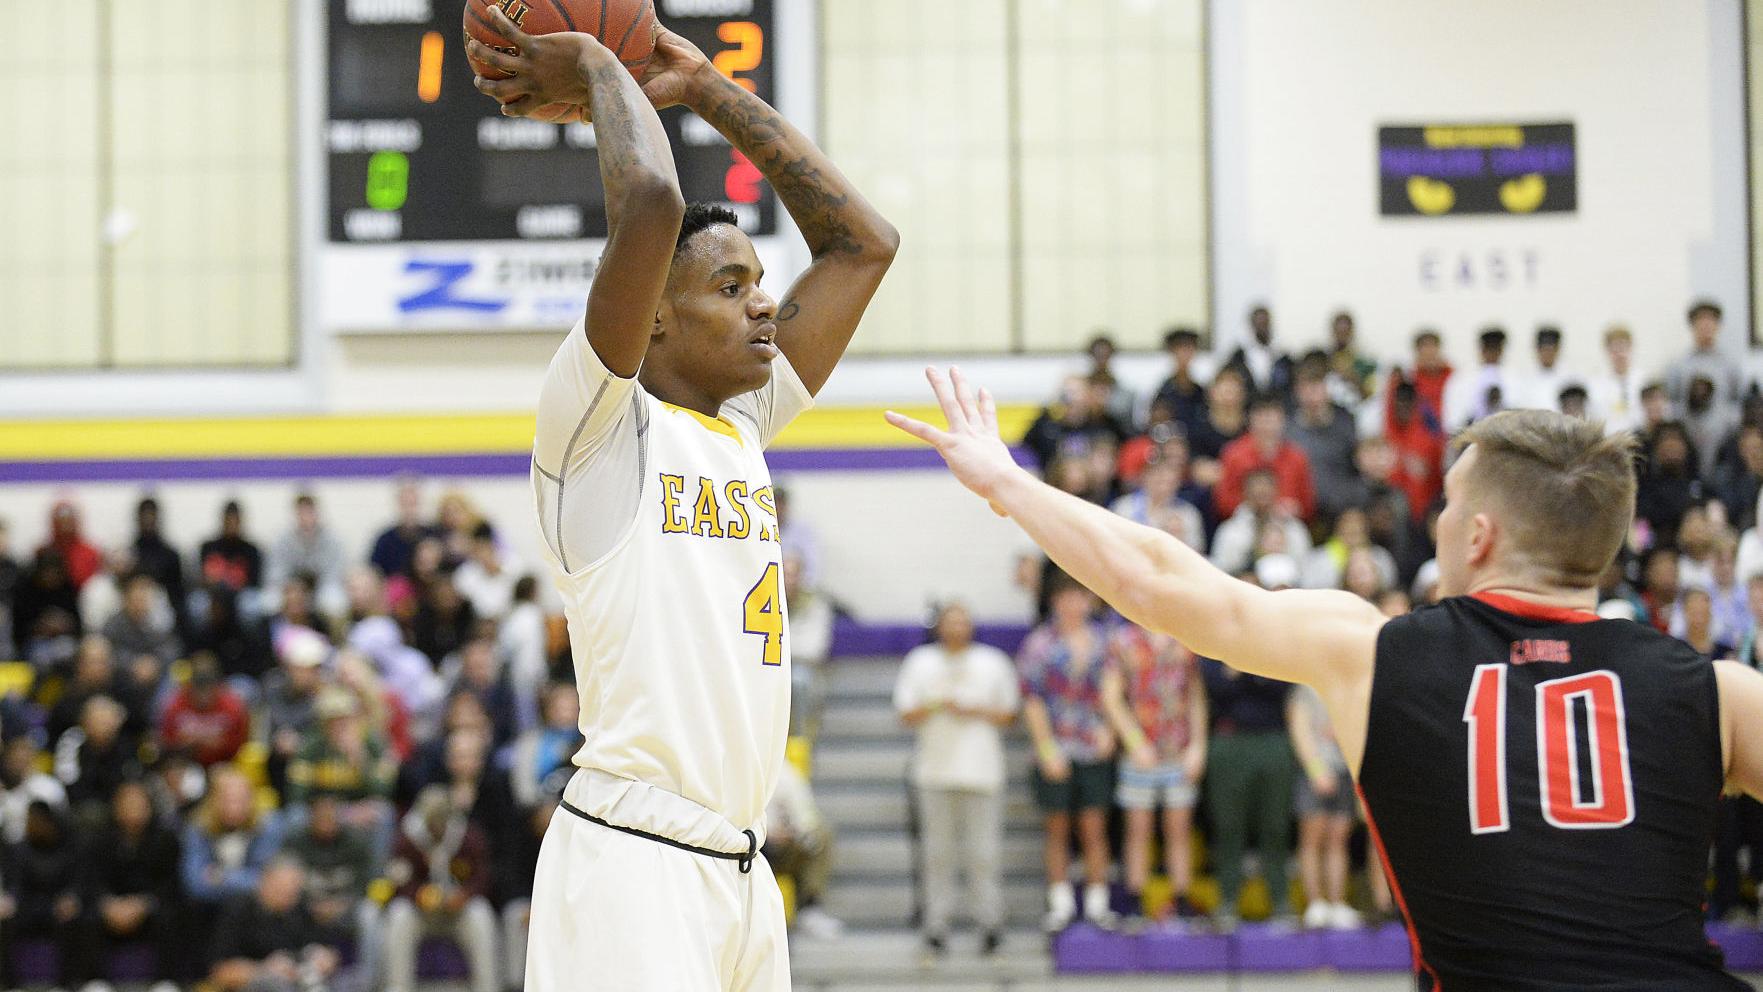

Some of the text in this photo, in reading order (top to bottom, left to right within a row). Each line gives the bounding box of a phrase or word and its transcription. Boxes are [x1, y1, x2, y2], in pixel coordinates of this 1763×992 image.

[418, 32, 444, 103] 1
[712, 21, 764, 94] 2
[1419, 249, 1539, 291] EAST
[742, 561, 784, 666] 4
[1463, 663, 1635, 834] 10
